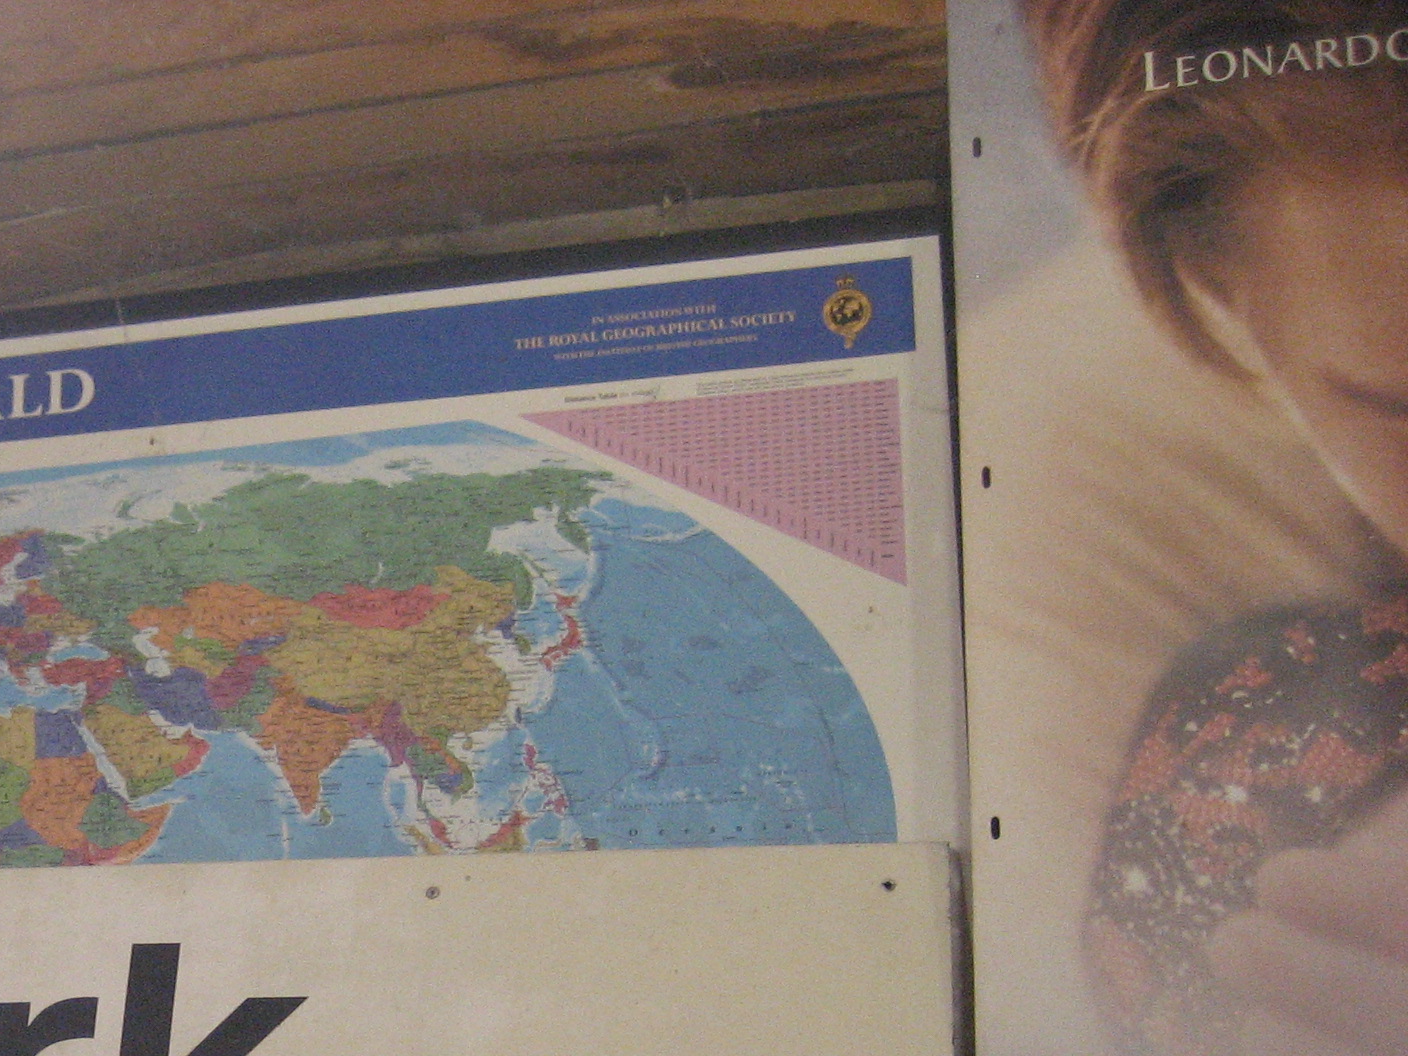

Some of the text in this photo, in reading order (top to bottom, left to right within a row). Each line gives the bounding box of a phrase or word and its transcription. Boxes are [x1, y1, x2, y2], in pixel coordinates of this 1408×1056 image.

[1144, 28, 1408, 92] LEONARDO
[515, 311, 797, 350] THE ROYAL GEOGRAPHICAL SOCIETY
